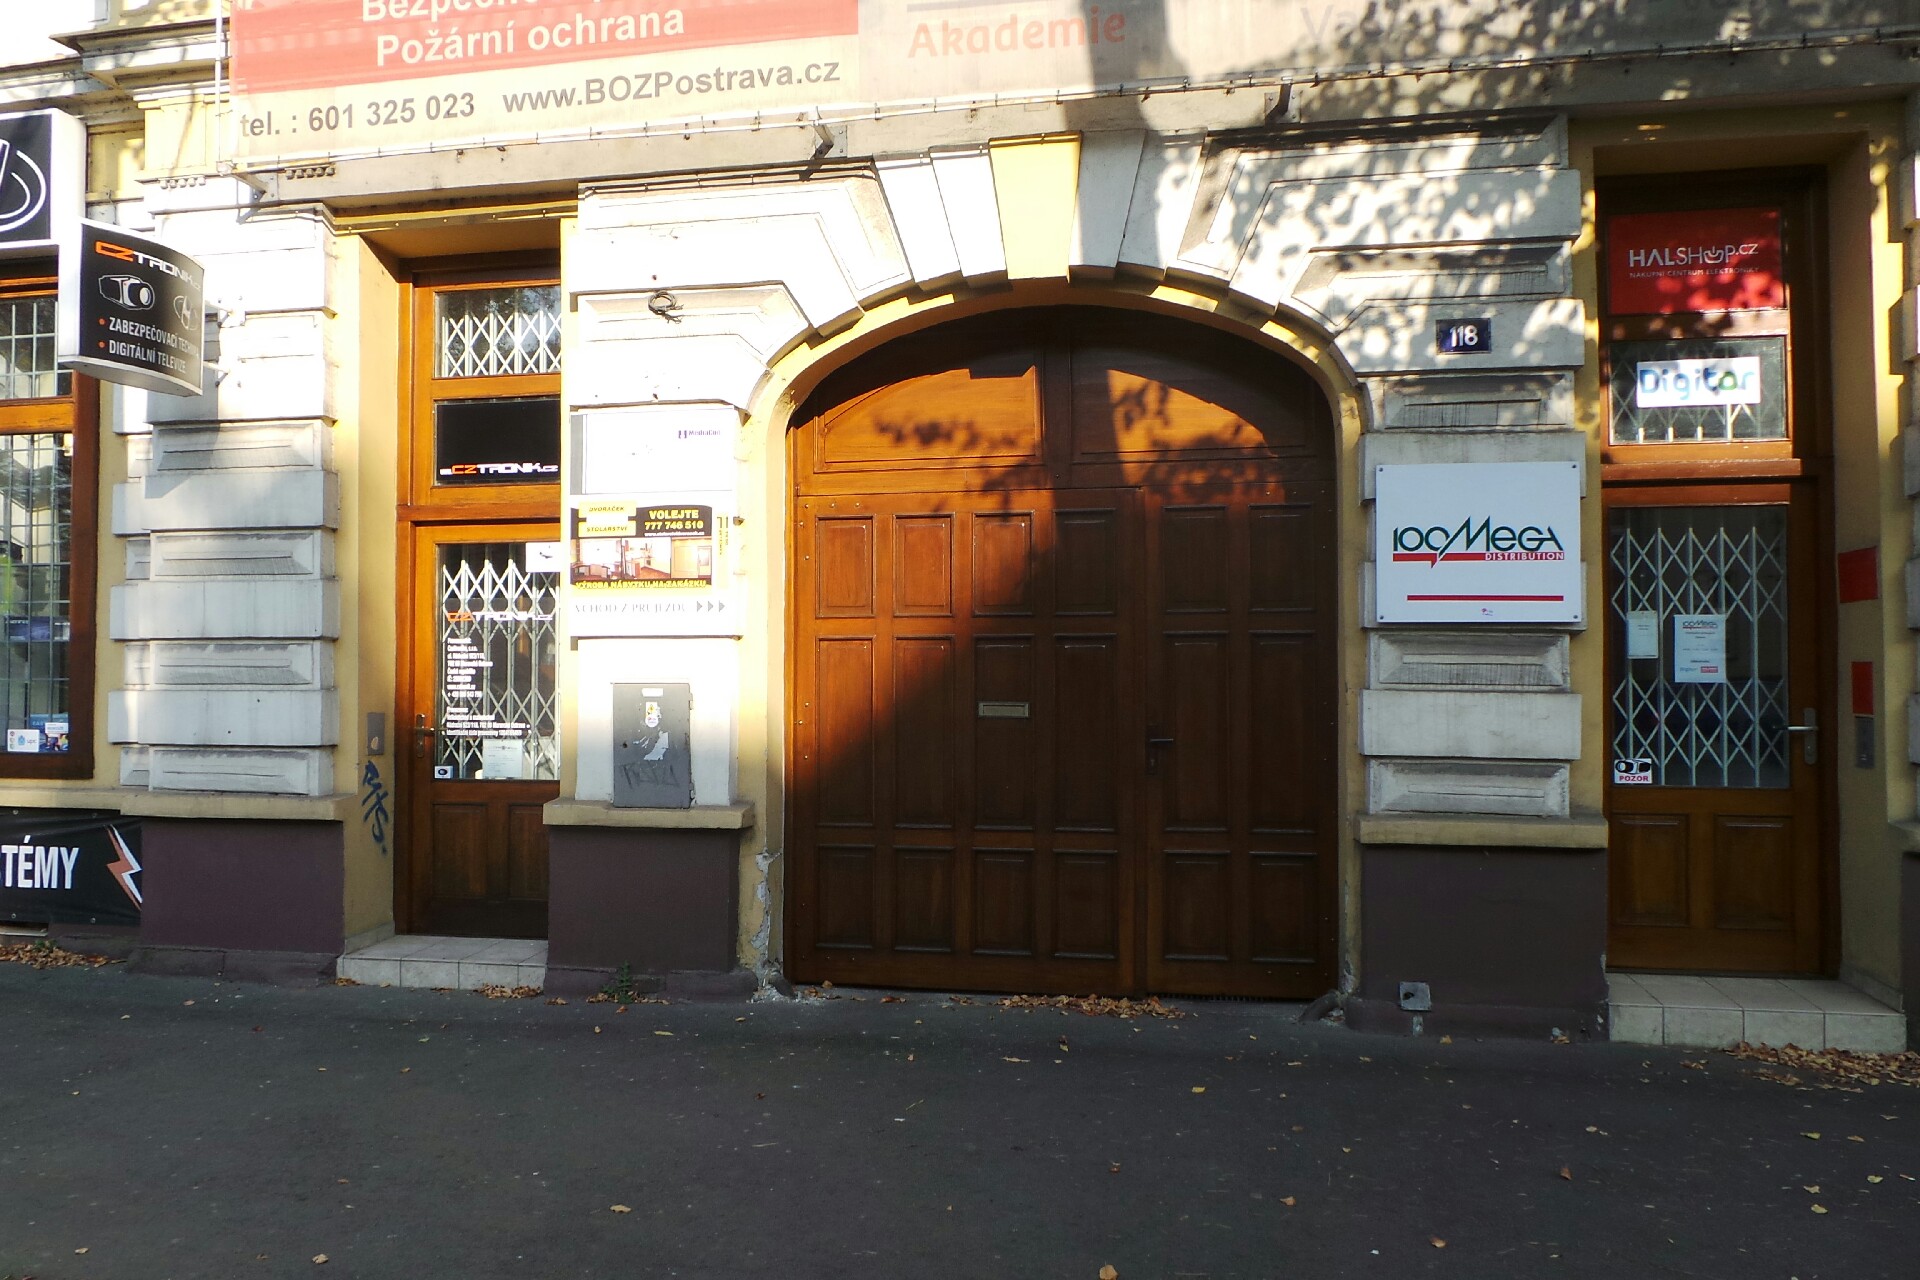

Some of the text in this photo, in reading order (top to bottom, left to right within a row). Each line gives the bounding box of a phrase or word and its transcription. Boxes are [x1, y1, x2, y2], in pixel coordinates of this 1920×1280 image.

[376, 8, 685, 67] Požární ochrana
[907, 4, 1126, 58] Akademie
[240, 111, 281, 138] tel.
[308, 104, 354, 132] 601
[366, 98, 416, 127] 325
[425, 92, 475, 121] 023
[502, 61, 841, 113] www.BOZPostrava.cz
[1667, 269, 1704, 277] CENTRUM
[108, 316, 179, 348] ZABEZPEČOVACÍ
[1449, 324, 1479, 348] 118
[108, 339, 187, 374] DIGITÁLNÍ TELEVIZE
[644, 521, 663, 531] 777
[648, 509, 700, 520] VOLEJTE
[1484, 551, 1565, 561] DISTRIBUTION
[575, 580, 610, 590] VÝROBA
[610, 580, 652, 590] NÁBYTKU
